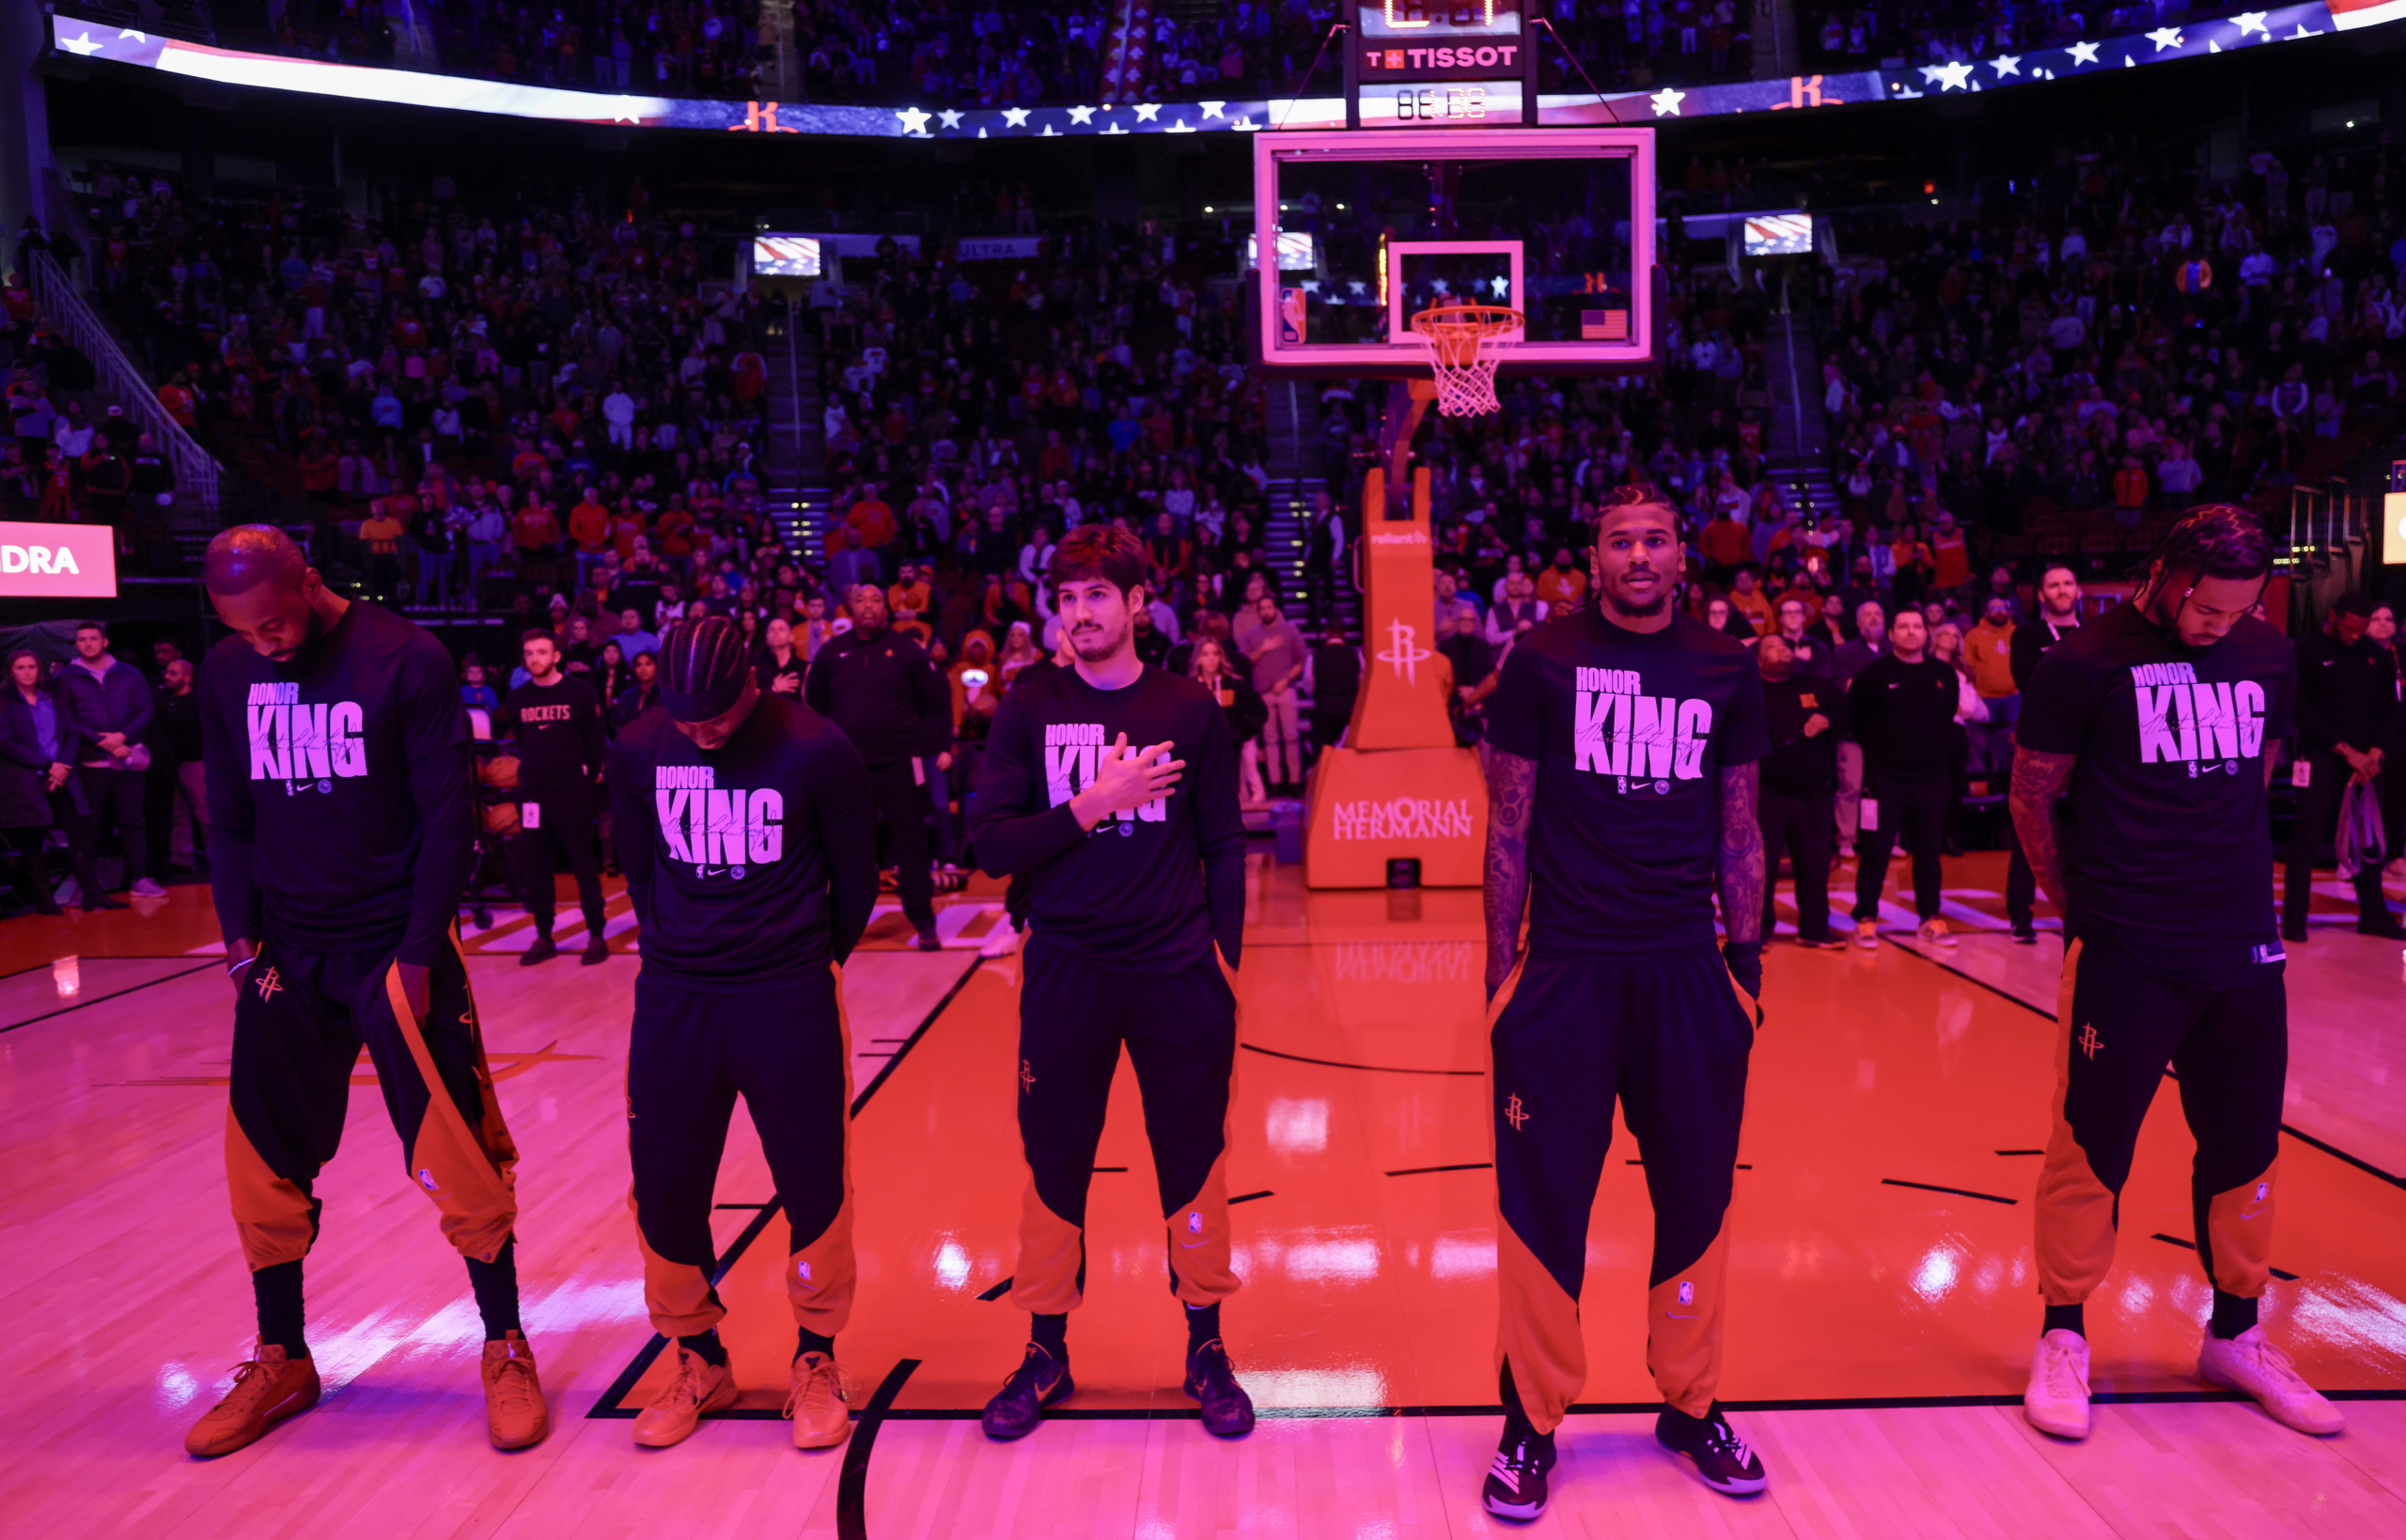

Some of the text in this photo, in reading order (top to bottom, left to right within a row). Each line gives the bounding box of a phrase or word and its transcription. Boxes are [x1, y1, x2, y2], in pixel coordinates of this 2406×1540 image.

[1407, 46, 1517, 69] TISSOT
[959, 243, 1015, 257] ULTRA
[0, 545, 80, 574] DRA
[1576, 666, 1641, 695] HONOR
[2130, 661, 2197, 687] HONOR
[247, 682, 299, 706] HONOR
[521, 705, 570, 723] ROCKETS
[2135, 680, 2265, 763] KING
[247, 701, 367, 780] KING
[1045, 723, 1105, 746] HONOR
[1574, 691, 1712, 780] KING
[656, 766, 714, 789] HONOR
[1334, 797, 1473, 822] MEMORIAL
[655, 787, 783, 864] KING
[1333, 816, 1472, 840] HERMANN
